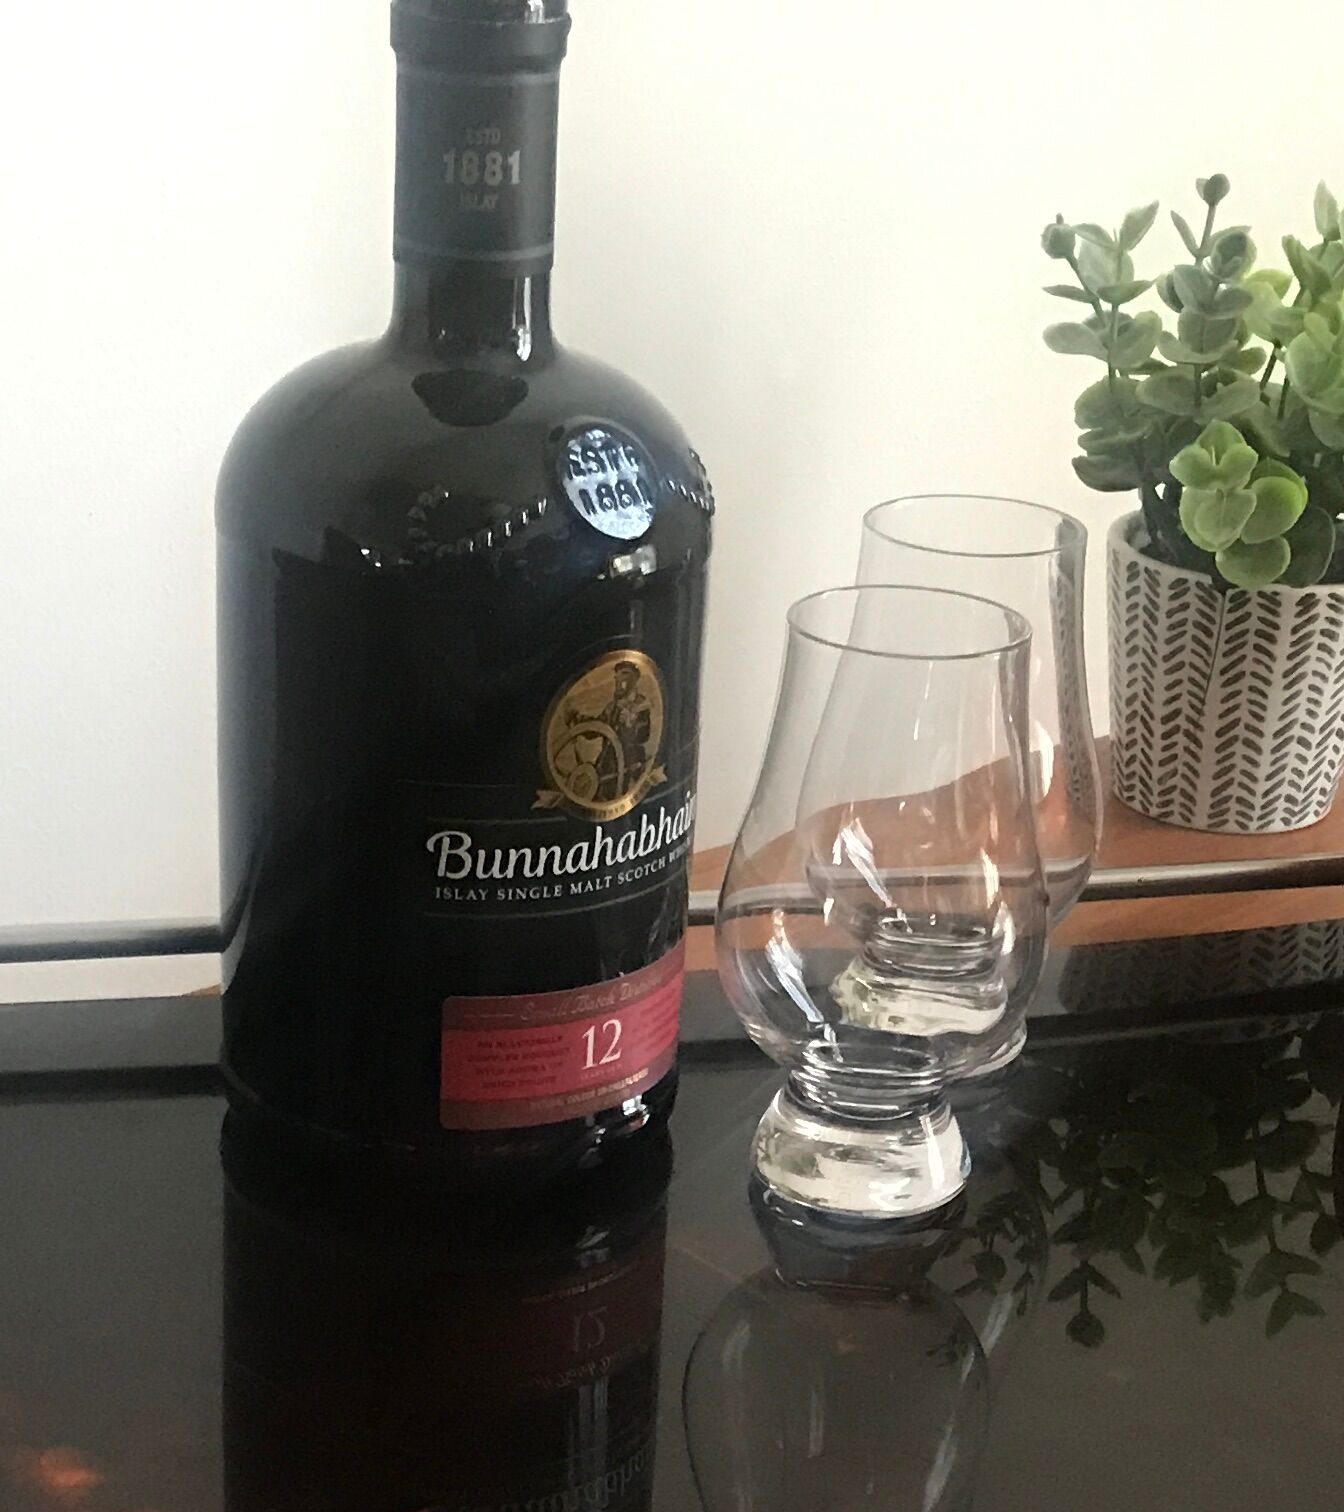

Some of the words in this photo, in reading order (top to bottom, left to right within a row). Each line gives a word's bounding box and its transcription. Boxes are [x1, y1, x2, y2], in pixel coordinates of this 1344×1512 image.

[442, 148, 522, 186] 1881
[435, 887, 489, 901] ISLAY
[498, 887, 563, 901] SINGLE
[570, 875, 613, 896] MALT
[617, 858, 666, 885] SCOTCH
[581, 1018, 623, 1071] 12
